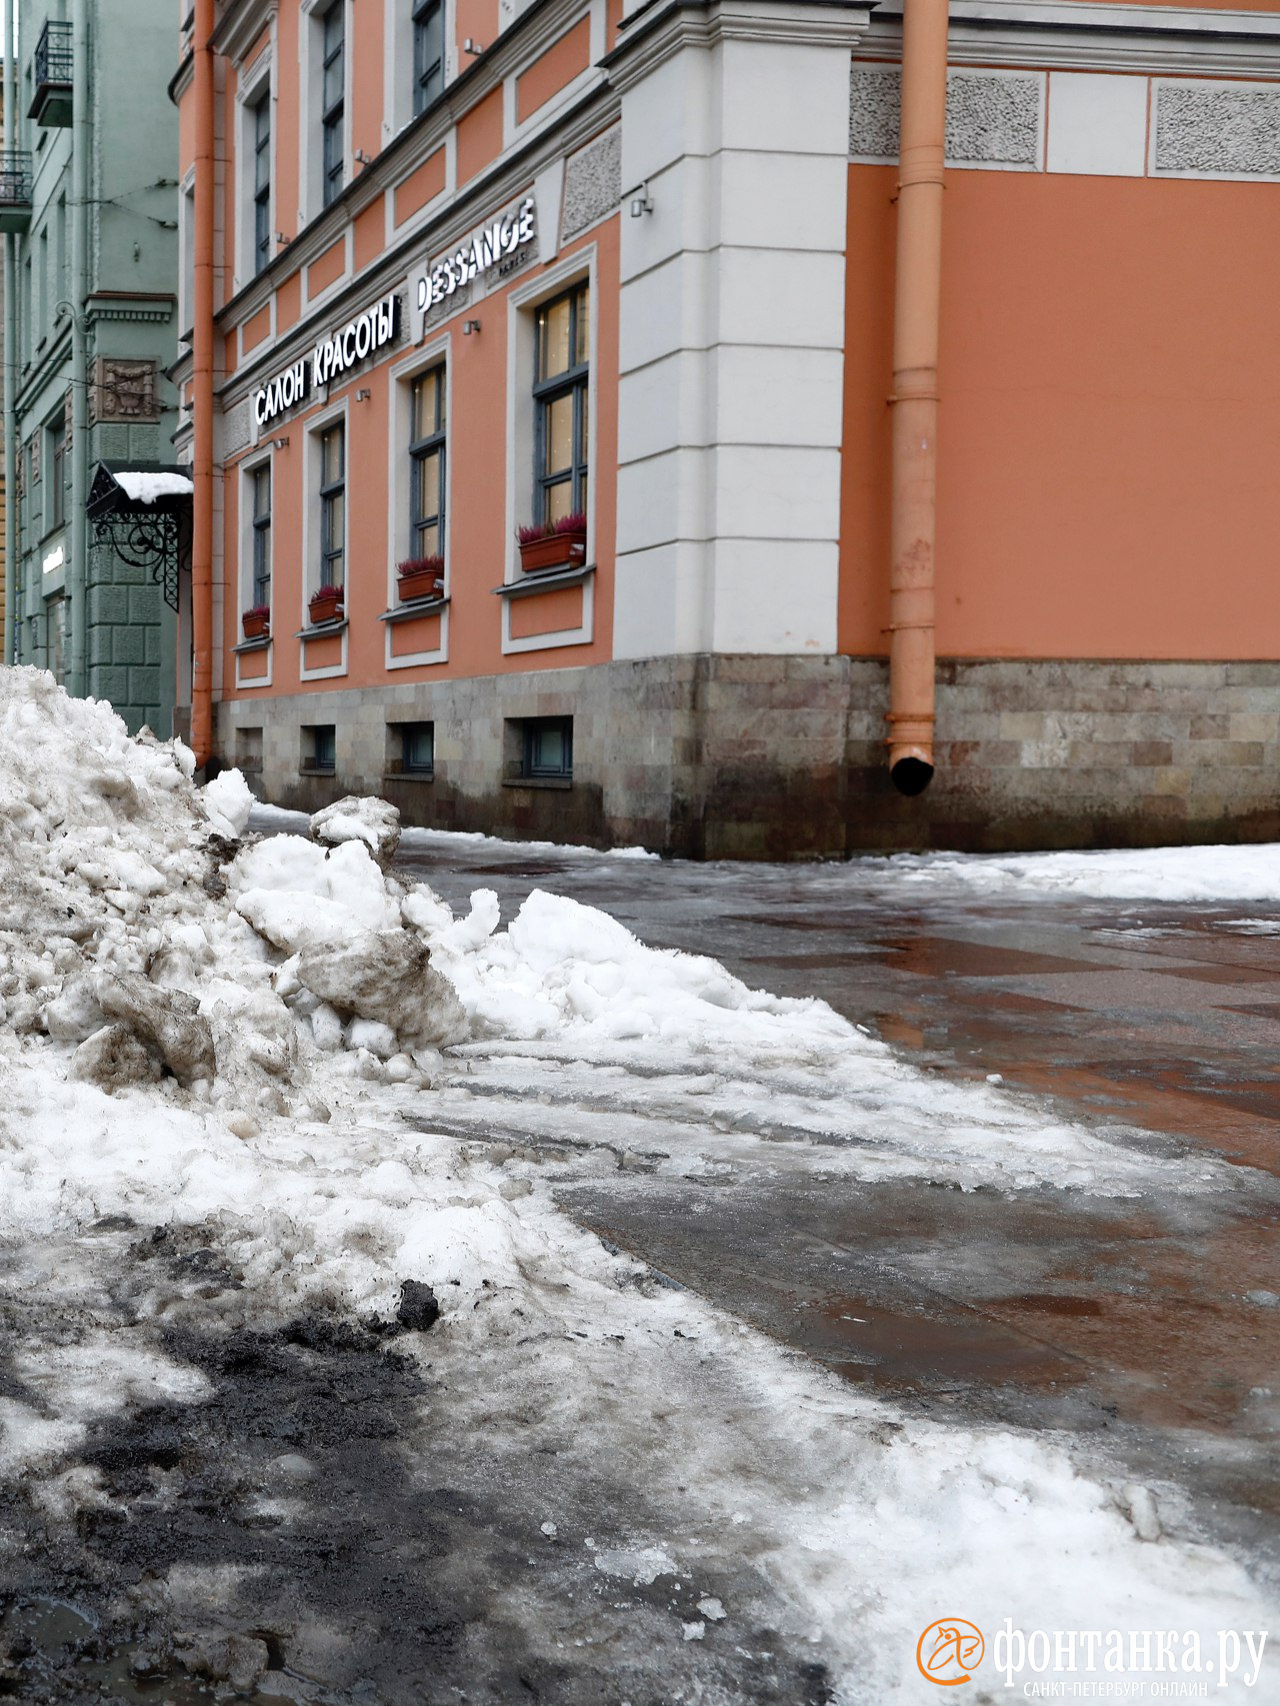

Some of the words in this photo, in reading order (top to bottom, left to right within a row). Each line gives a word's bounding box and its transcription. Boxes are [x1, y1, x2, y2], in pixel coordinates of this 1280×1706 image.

[418, 198, 534, 312] DESSANGE
[255, 360, 305, 425] САЛОН
[314, 294, 396, 387] КРАСОТЫ
